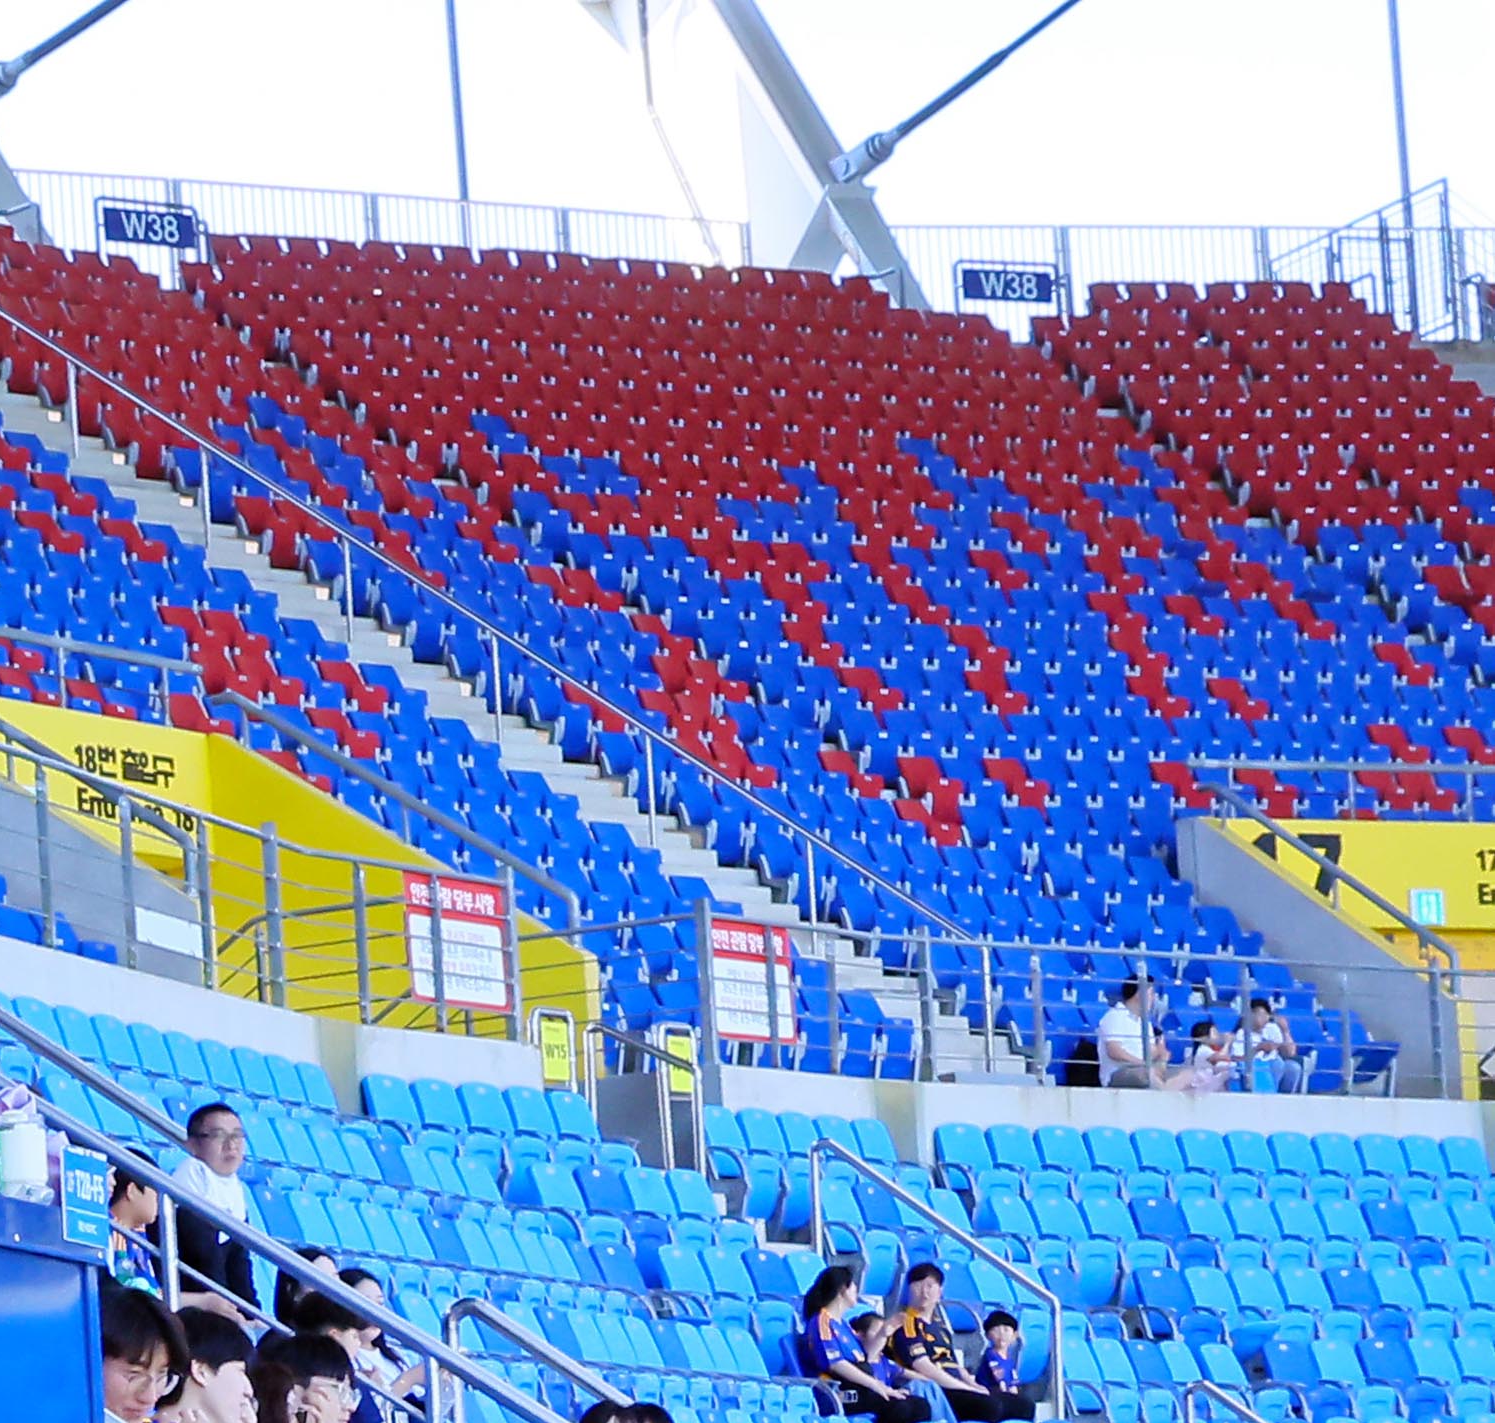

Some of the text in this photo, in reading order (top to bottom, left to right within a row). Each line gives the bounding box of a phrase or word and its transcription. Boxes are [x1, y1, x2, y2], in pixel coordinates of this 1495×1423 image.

[121, 212, 179, 243] W38
[980, 272, 1037, 299] W38
[75, 745, 175, 788] 18번 출입구
